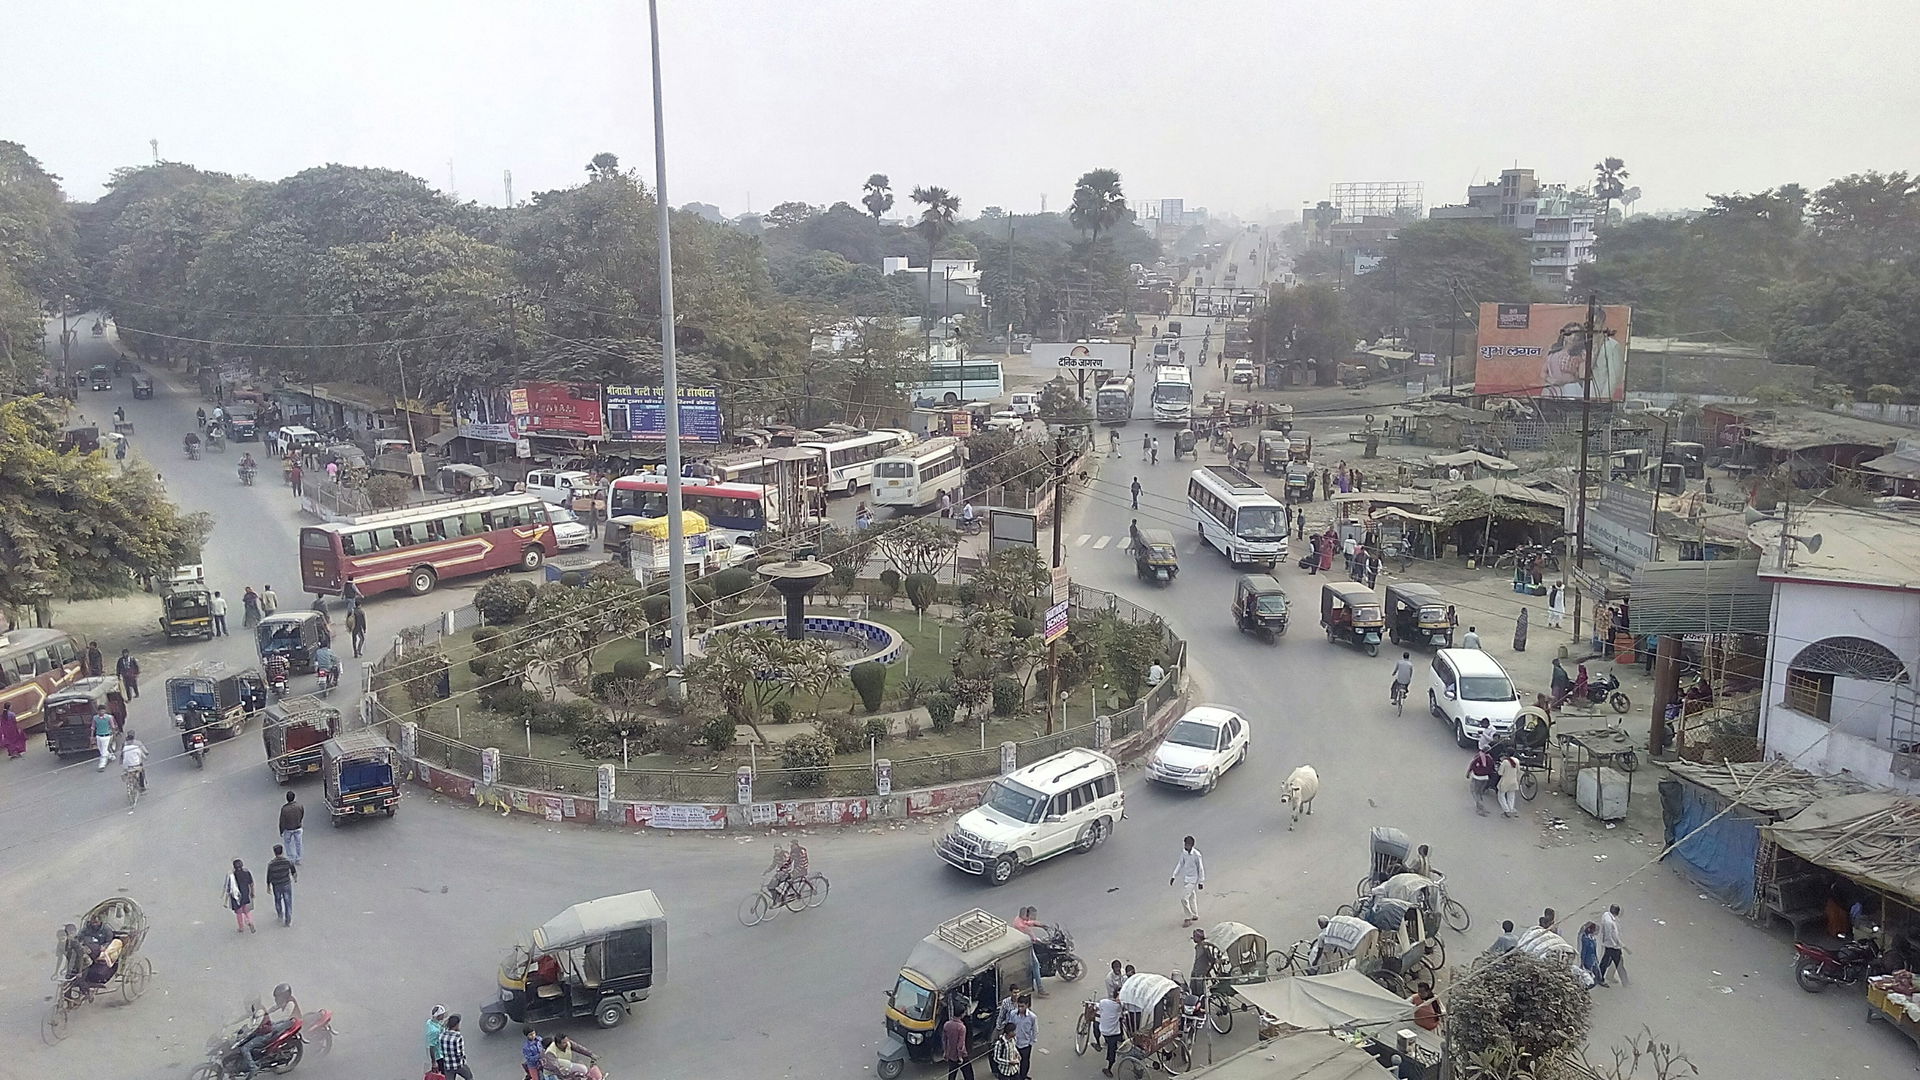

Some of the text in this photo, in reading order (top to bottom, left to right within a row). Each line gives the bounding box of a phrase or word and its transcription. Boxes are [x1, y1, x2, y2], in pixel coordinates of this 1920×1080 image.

[1480, 346, 1542, 359] शुभ लगन
[1058, 356, 1103, 367] दैनिक जागरण
[1046, 610, 1068, 629] SCHOOL
